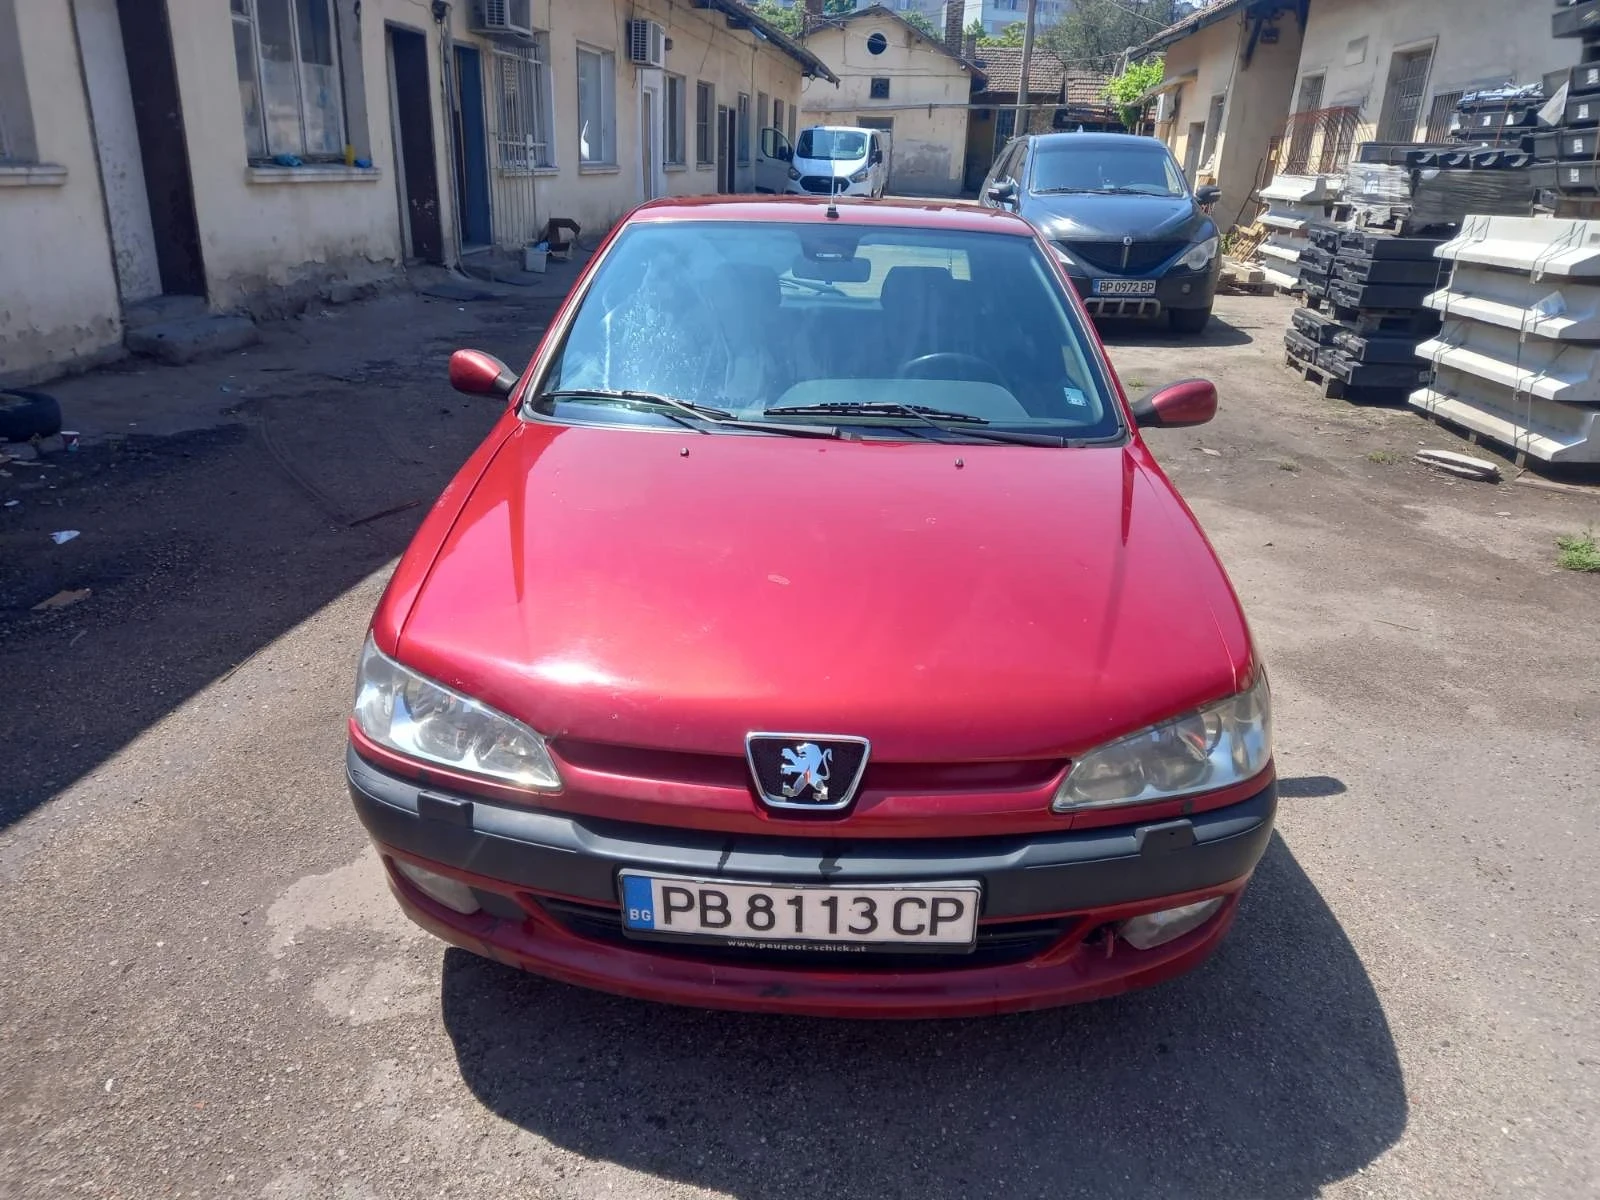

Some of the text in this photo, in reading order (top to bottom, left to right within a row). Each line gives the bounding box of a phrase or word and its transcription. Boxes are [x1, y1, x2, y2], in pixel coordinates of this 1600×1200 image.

[1100, 282, 1155, 293] BP 0972 BP
[630, 908, 651, 921] BG
[662, 886, 965, 937] PB 8113 CP
